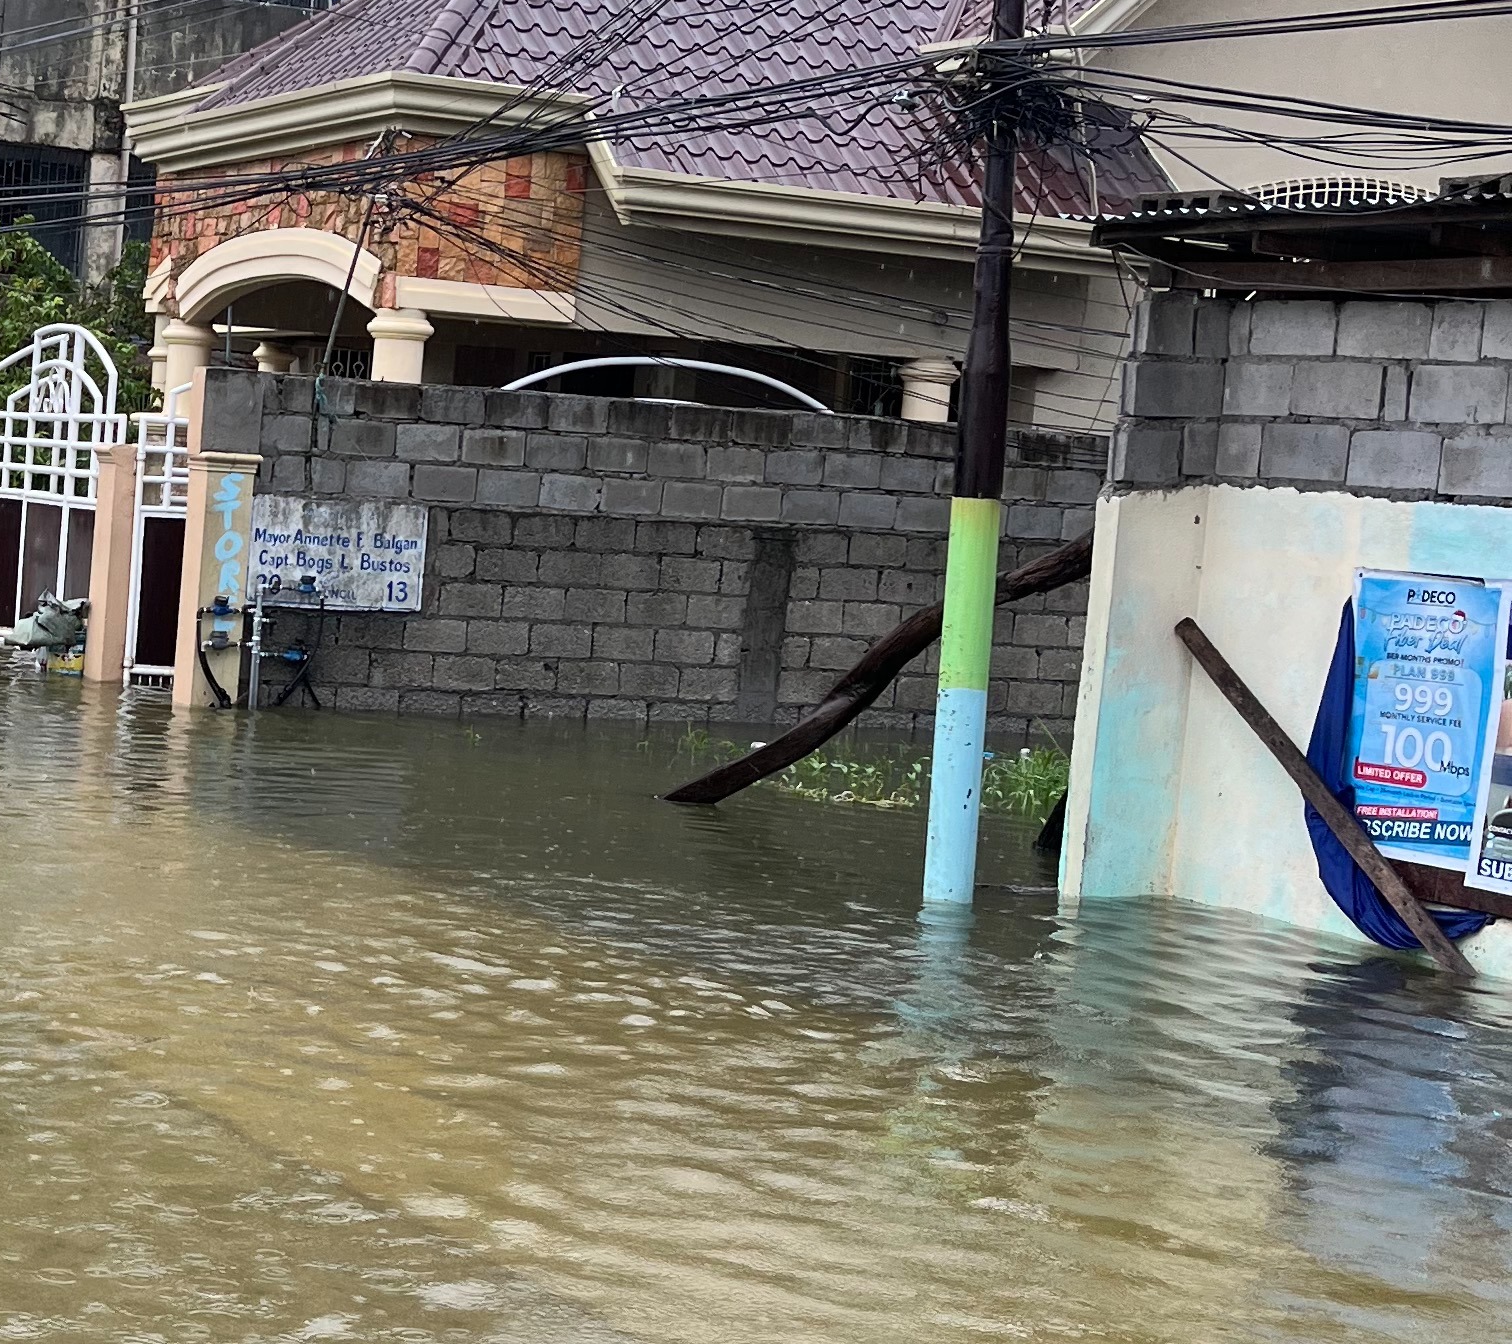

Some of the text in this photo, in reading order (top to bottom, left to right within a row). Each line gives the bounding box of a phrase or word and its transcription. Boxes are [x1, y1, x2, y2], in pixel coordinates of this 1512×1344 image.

[254, 528, 291, 546] Mayor
[293, 528, 350, 548] Annette
[374, 533, 418, 554] Balgan
[296, 550, 333, 574] Bogs
[360, 552, 410, 574] Bustos
[387, 580, 408, 603] 13
[1400, 654, 1431, 664] MONTHS
[1393, 664, 1456, 682] PLAN 999
[1394, 682, 1454, 716] 999
[1380, 710, 1462, 728] MONTHLY SERVICE FEE
[1381, 724, 1470, 780] 100 Mbps
[1357, 765, 1423, 784] LIMITED OFFER
[1356, 806, 1377, 816] FREE
